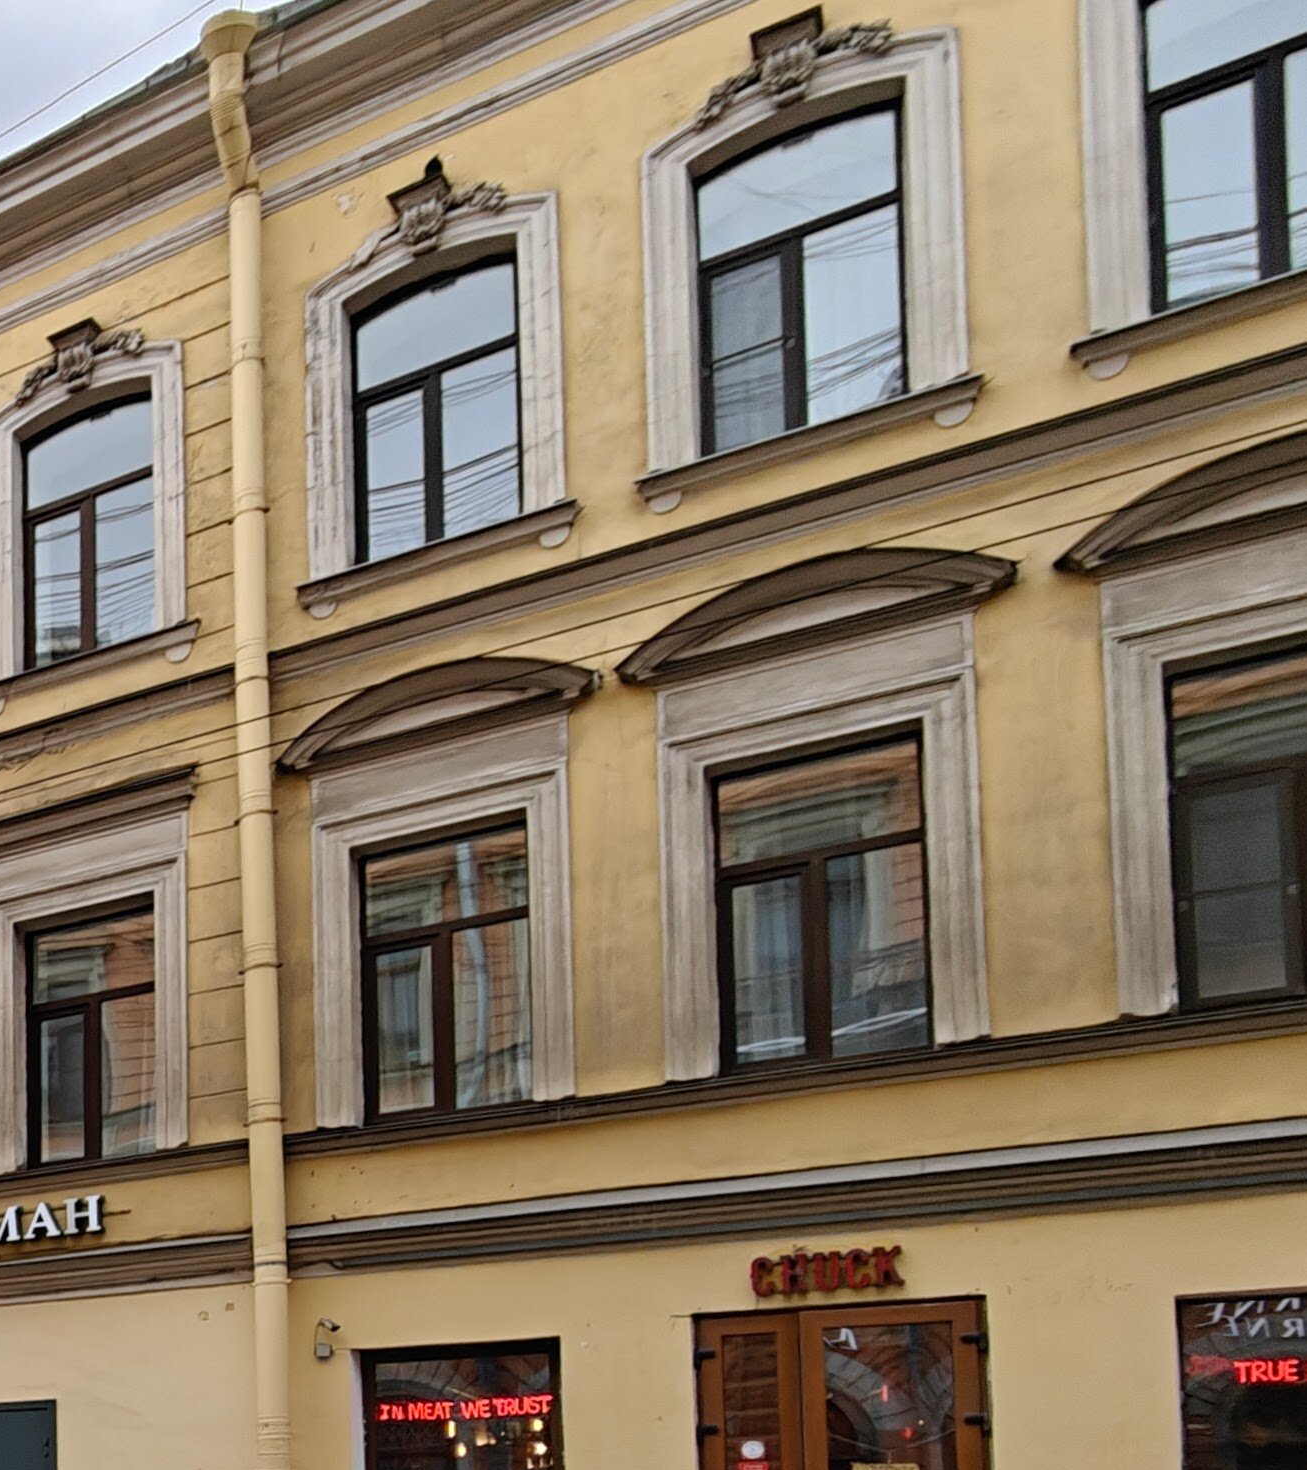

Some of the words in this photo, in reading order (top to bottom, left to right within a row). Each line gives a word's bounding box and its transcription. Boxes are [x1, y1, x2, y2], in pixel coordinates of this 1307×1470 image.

[751, 1245, 905, 1297] CHUCK
[1232, 1359, 1299, 1383] TRUE
[379, 1404, 403, 1421] IN
[408, 1401, 454, 1421] MEAT
[460, 1398, 491, 1420] WE
[492, 1394, 553, 1417] TRUST
